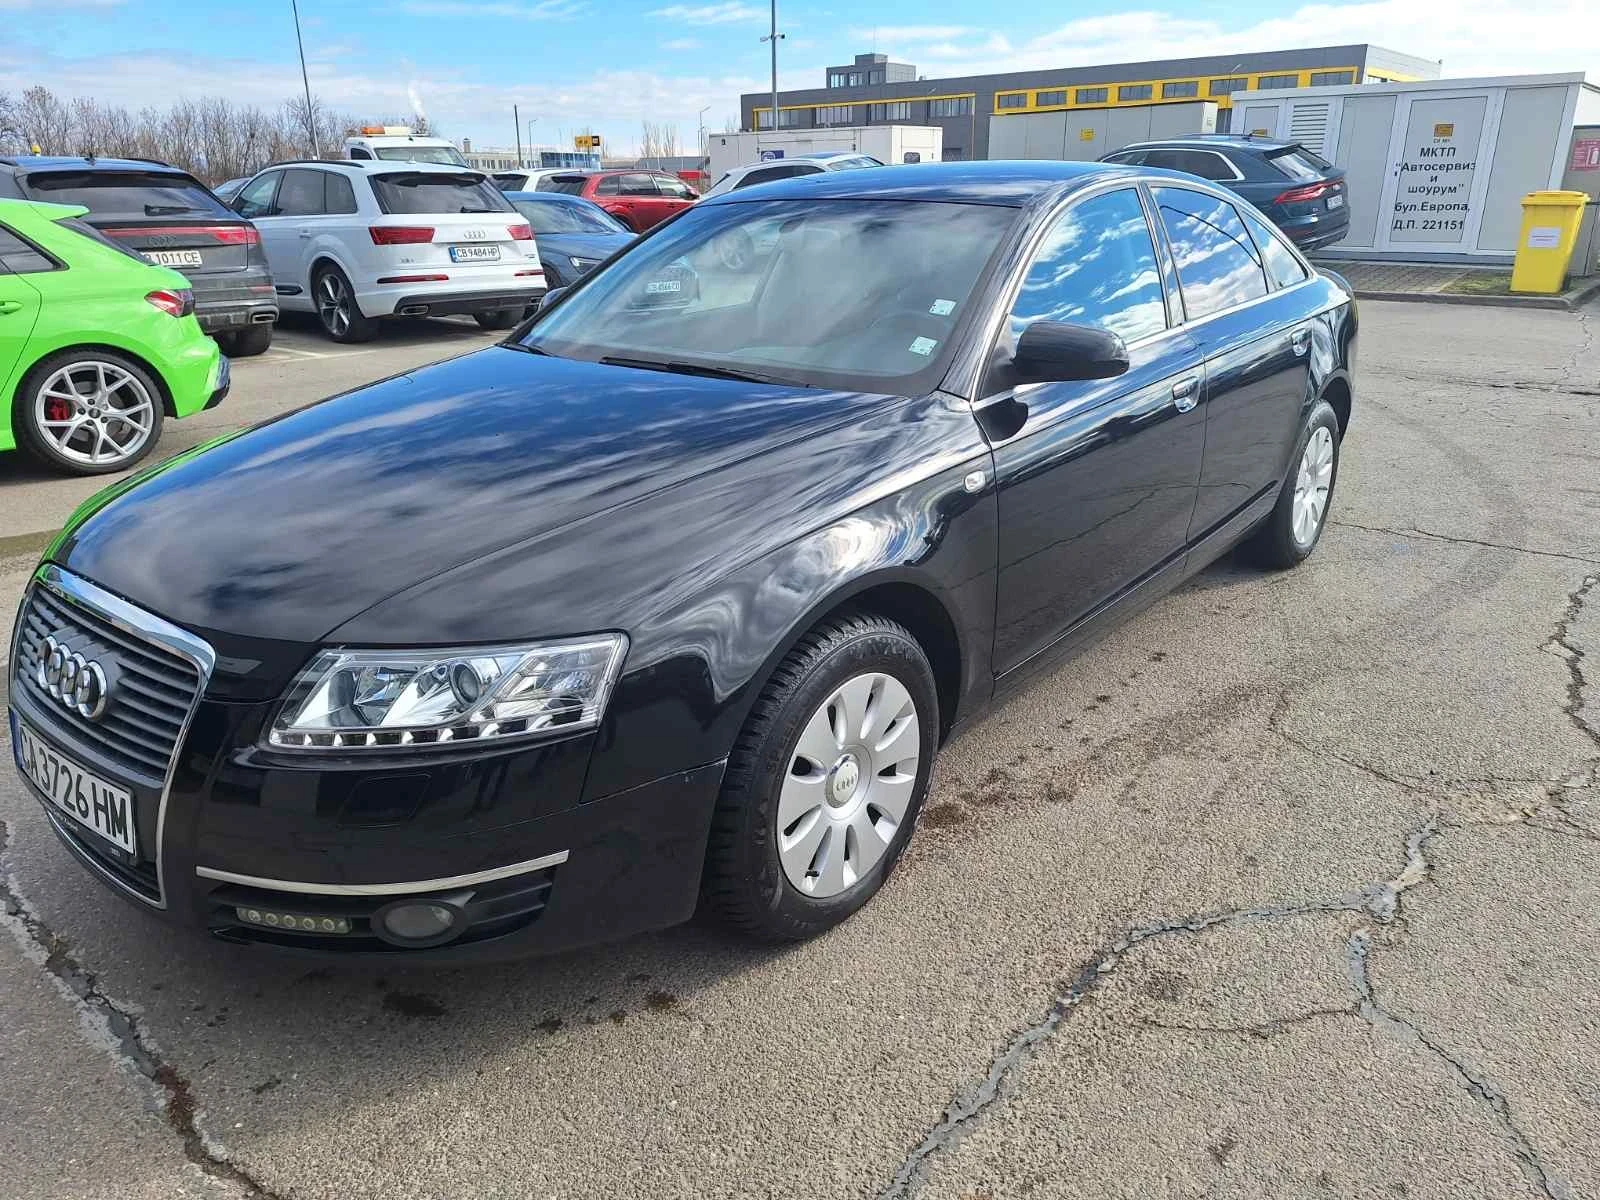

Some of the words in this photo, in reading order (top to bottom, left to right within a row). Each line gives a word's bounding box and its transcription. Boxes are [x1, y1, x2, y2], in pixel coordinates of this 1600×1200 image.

[1420, 147, 1456, 157] МКТП
[1393, 220, 1418, 231] Д.П.
[1422, 220, 1464, 230] 221151
